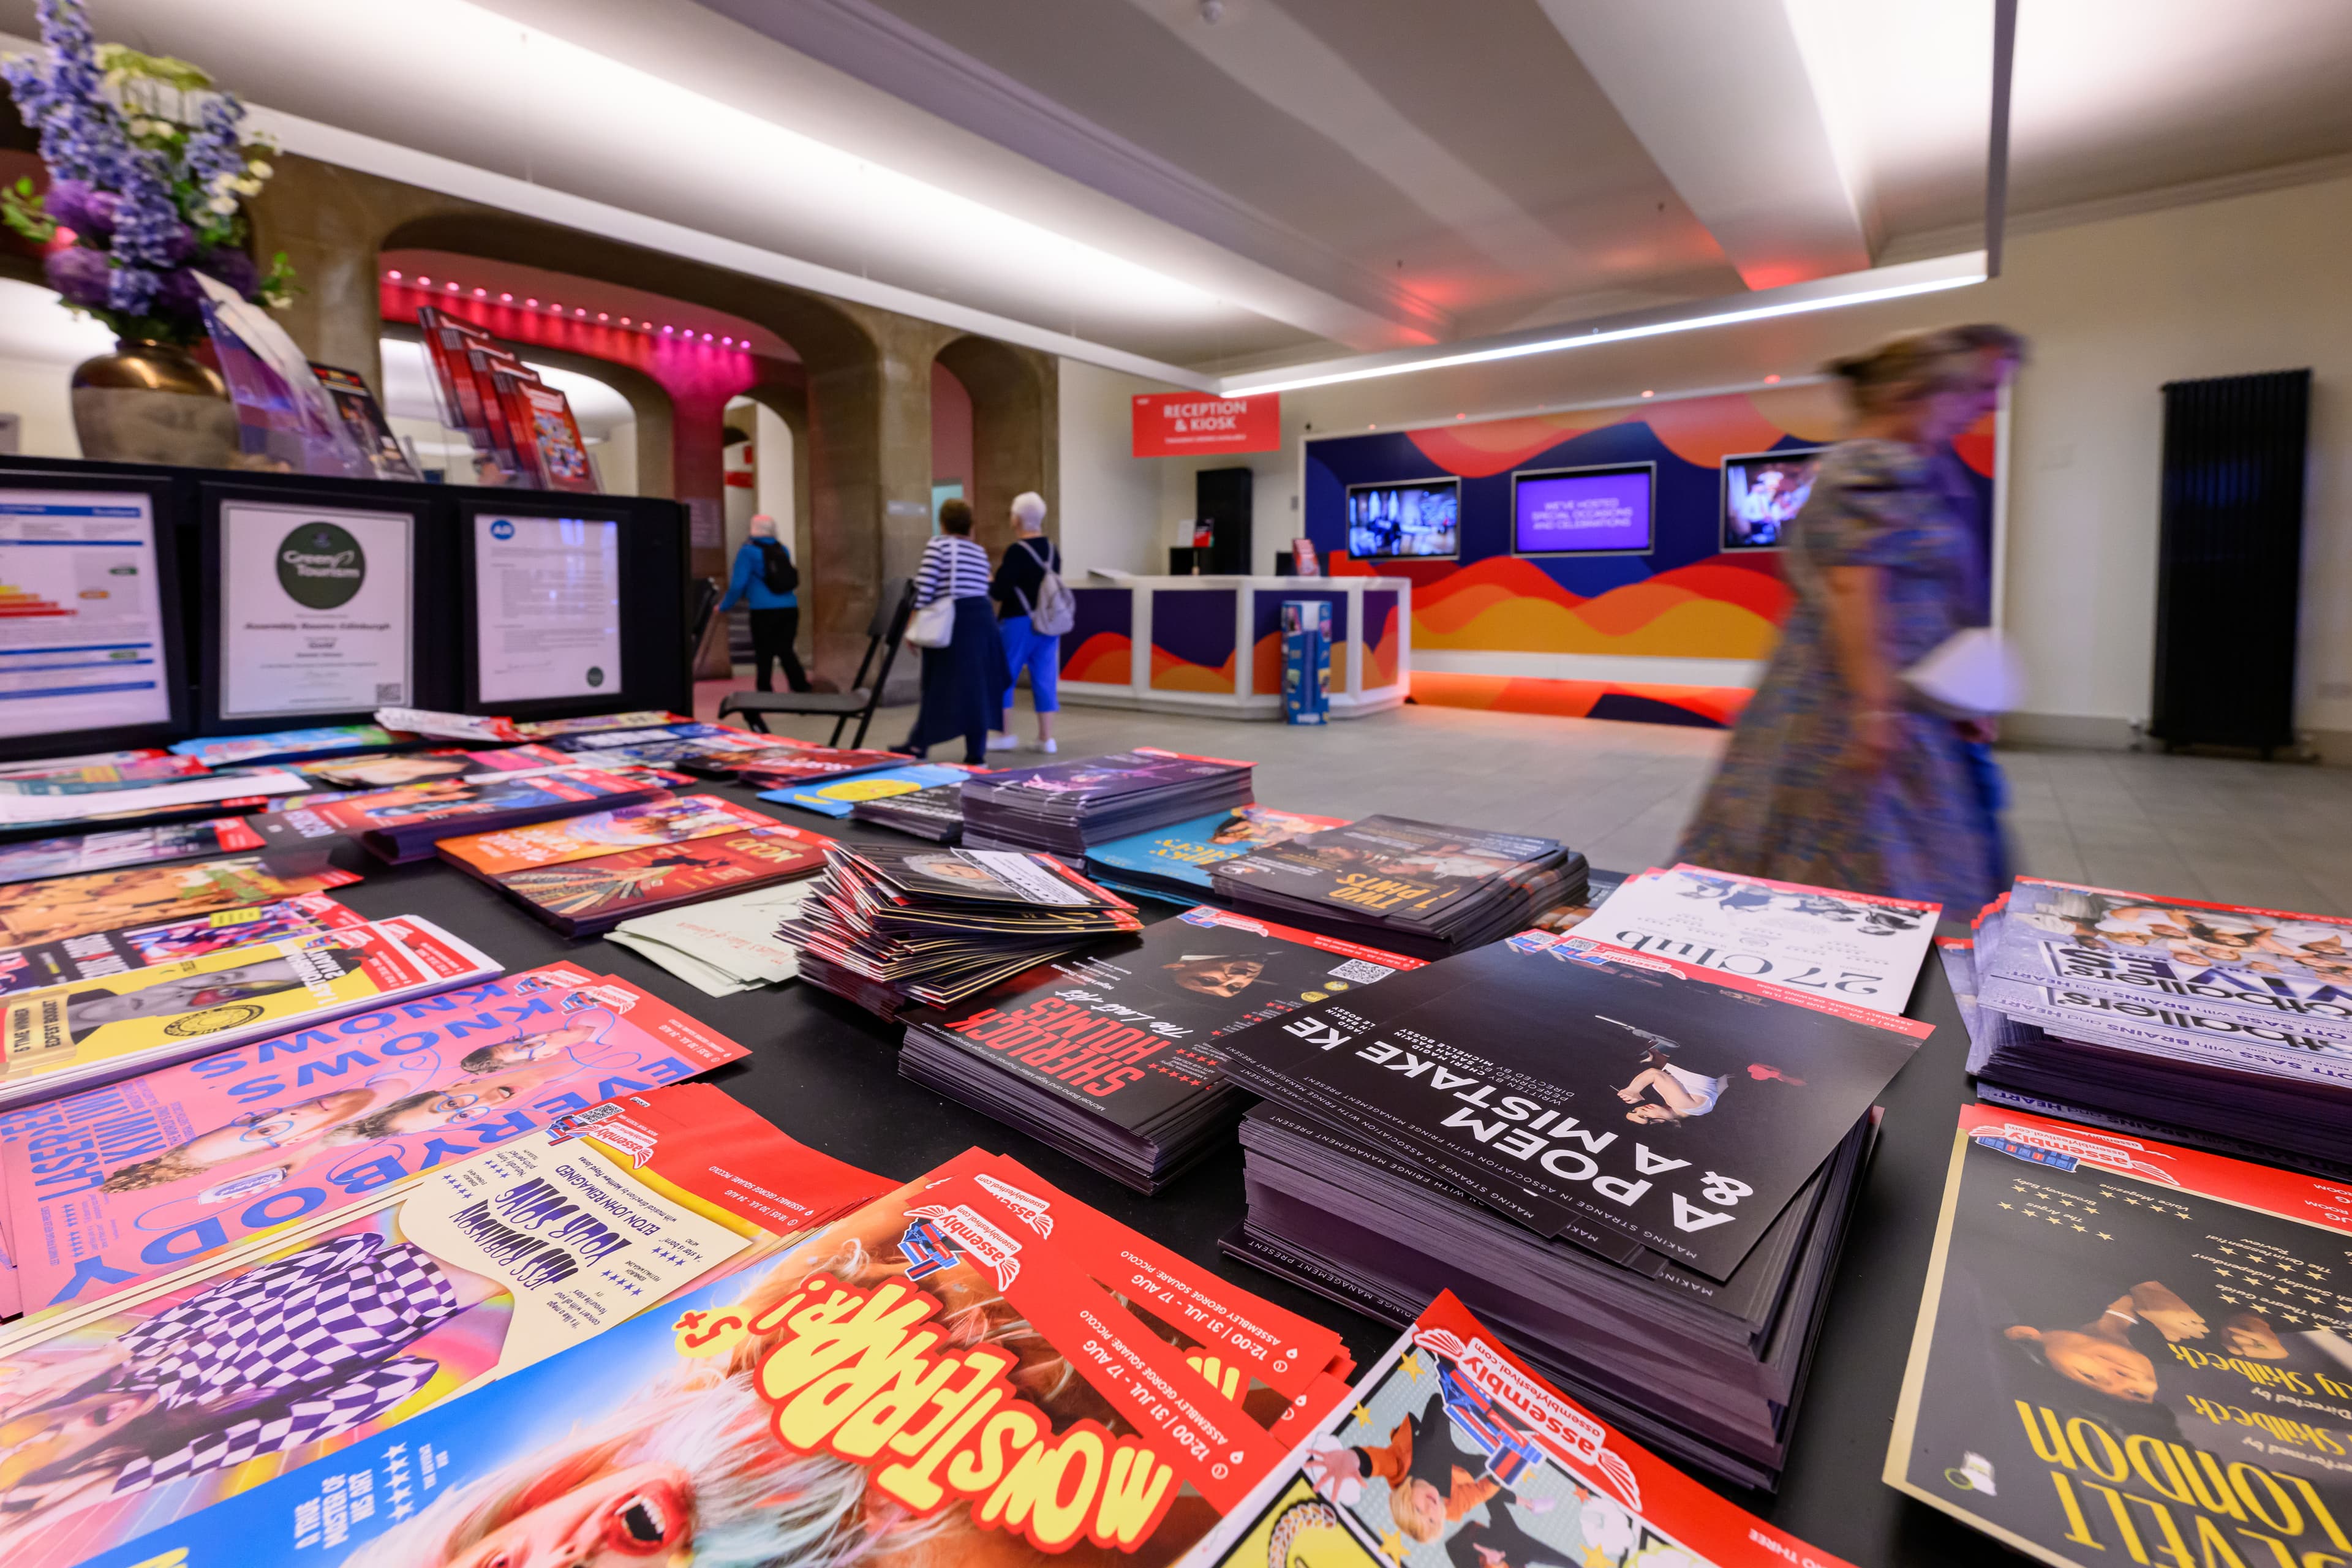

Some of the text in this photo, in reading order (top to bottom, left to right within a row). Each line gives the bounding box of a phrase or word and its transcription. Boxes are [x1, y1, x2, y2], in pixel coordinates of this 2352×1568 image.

[1164, 401, 1246, 417] RECEPTION
[1175, 417, 1236, 431] & KIOSK
[283, 551, 331, 567] Green
[296, 566, 360, 579] Tourism
[1329, 886, 1401, 909] TWO
[1615, 930, 1773, 974] Club
[1782, 967, 1883, 994] 27
[1866, 1011, 1913, 1025] ASSEMBLY
[2076, 982, 2294, 1030] SASS with BRAINS and
[190, 983, 507, 1080] KNOWS
[1010, 996, 1172, 1065] HOLMES
[1393, 1031, 1436, 1049] BASKIN
[1398, 1029, 1436, 1044] BOSSY
[2067, 1014, 2302, 1069] SASS with BRAINS and
[227, 998, 554, 1104] KNOWS
[943, 1007, 1146, 1097] SHERLOCK
[1225, 1045, 1257, 1065] PRESENT
[1411, 1044, 1448, 1061] MAGID
[1436, 1048, 1475, 1065] SARAH
[1437, 1042, 1493, 1066] MICHELLE
[940, 1030, 1107, 1112] Michael Blaha and Nigel Fringe Management
[1240, 1069, 1275, 1087] PRESENT
[1256, 1062, 1307, 1093] MANAGEMENT
[1450, 1060, 1485, 1076] CHERI
[1515, 1072, 1574, 1096] DIRECTED
[1307, 1089, 1337, 1108] FRINGE
[1496, 1072, 1568, 1101] PERFORMED
[1507, 1083, 1561, 1105] WRITTEN
[1336, 1106, 1360, 1123] WITH
[1355, 1039, 1754, 1206] & A MISTAKE
[92, 1109, 167, 1164] KIWI
[594, 1128, 643, 1151] assembly
[1361, 1120, 1423, 1156] ASSOCIATION
[2004, 1132, 2128, 1165] assembly
[2008, 1125, 2125, 1156] assemblyfestival.com
[28, 1126, 105, 1202] LASER
[1268, 1115, 1464, 1198] WITH FRINGE MANAGEMENT PRESENT
[1302, 1076, 1697, 1259] MAKING STRANGE IN ASSOCIATION WITH FRINGE MANAGEMENT PRESENT
[1439, 1106, 1735, 1233] A POEM
[44, 1057, 695, 1307] EVERYBODY
[578, 1156, 677, 1222] with musical direction Matthew Floyd Jones
[709, 1166, 807, 1212] ASSEMBLY GEORGE PICCOLO
[725, 1189, 741, 1198] AUG
[978, 1176, 1046, 1208] assemblyfestival.com
[1438, 1164, 1488, 1193] STRANGE
[2013, 1177, 2098, 1206] Broadway Baby
[555, 1164, 661, 1236] ELTON JOHN REIMAGINED
[748, 1200, 763, 1209] JUL
[1490, 1192, 1534, 1218] MAKING
[2026, 1202, 2083, 1223] The Argus
[2098, 1183, 2190, 1212] Voice Magazine
[495, 1177, 632, 1267] YOUR SONG
[770, 1211, 788, 1222] 18:05
[957, 1207, 1017, 1251] assemblyfestival.com
[449, 1199, 578, 1291] JESS ROBINSON
[938, 1215, 1005, 1262] assembly
[2205, 1235, 2332, 1274] The Quintessential
[2240, 1238, 2289, 1255] Review
[1248, 1240, 1373, 1299] MANAGEMENT PRESENT
[2191, 1253, 2333, 1297] Sunday Independent
[584, 1297, 607, 1316] favourite
[1120, 1250, 1281, 1346] ASSEMBLEY GEORGE SQUARE: PICCOLO
[2215, 1284, 2308, 1316] Theare Guide
[579, 1310, 600, 1325] concert
[1131, 1274, 1268, 1360] 12:00 31 JUL 17 AUG
[1079, 1310, 1228, 1446] ASSEMBLEY GEORGE SQUARE: PICCOLO
[2166, 1343, 2315, 1396] Skilbeck
[1083, 1340, 1210, 1461] 12:00 31 JUL 17 AUG
[1463, 1356, 1596, 1456] assembly
[1474, 1343, 1600, 1437] assemblyfestival.com
[2250, 1386, 2272, 1401] by
[2185, 1394, 2346, 1455] Skilbeck
[2242, 1436, 2264, 1452] by
